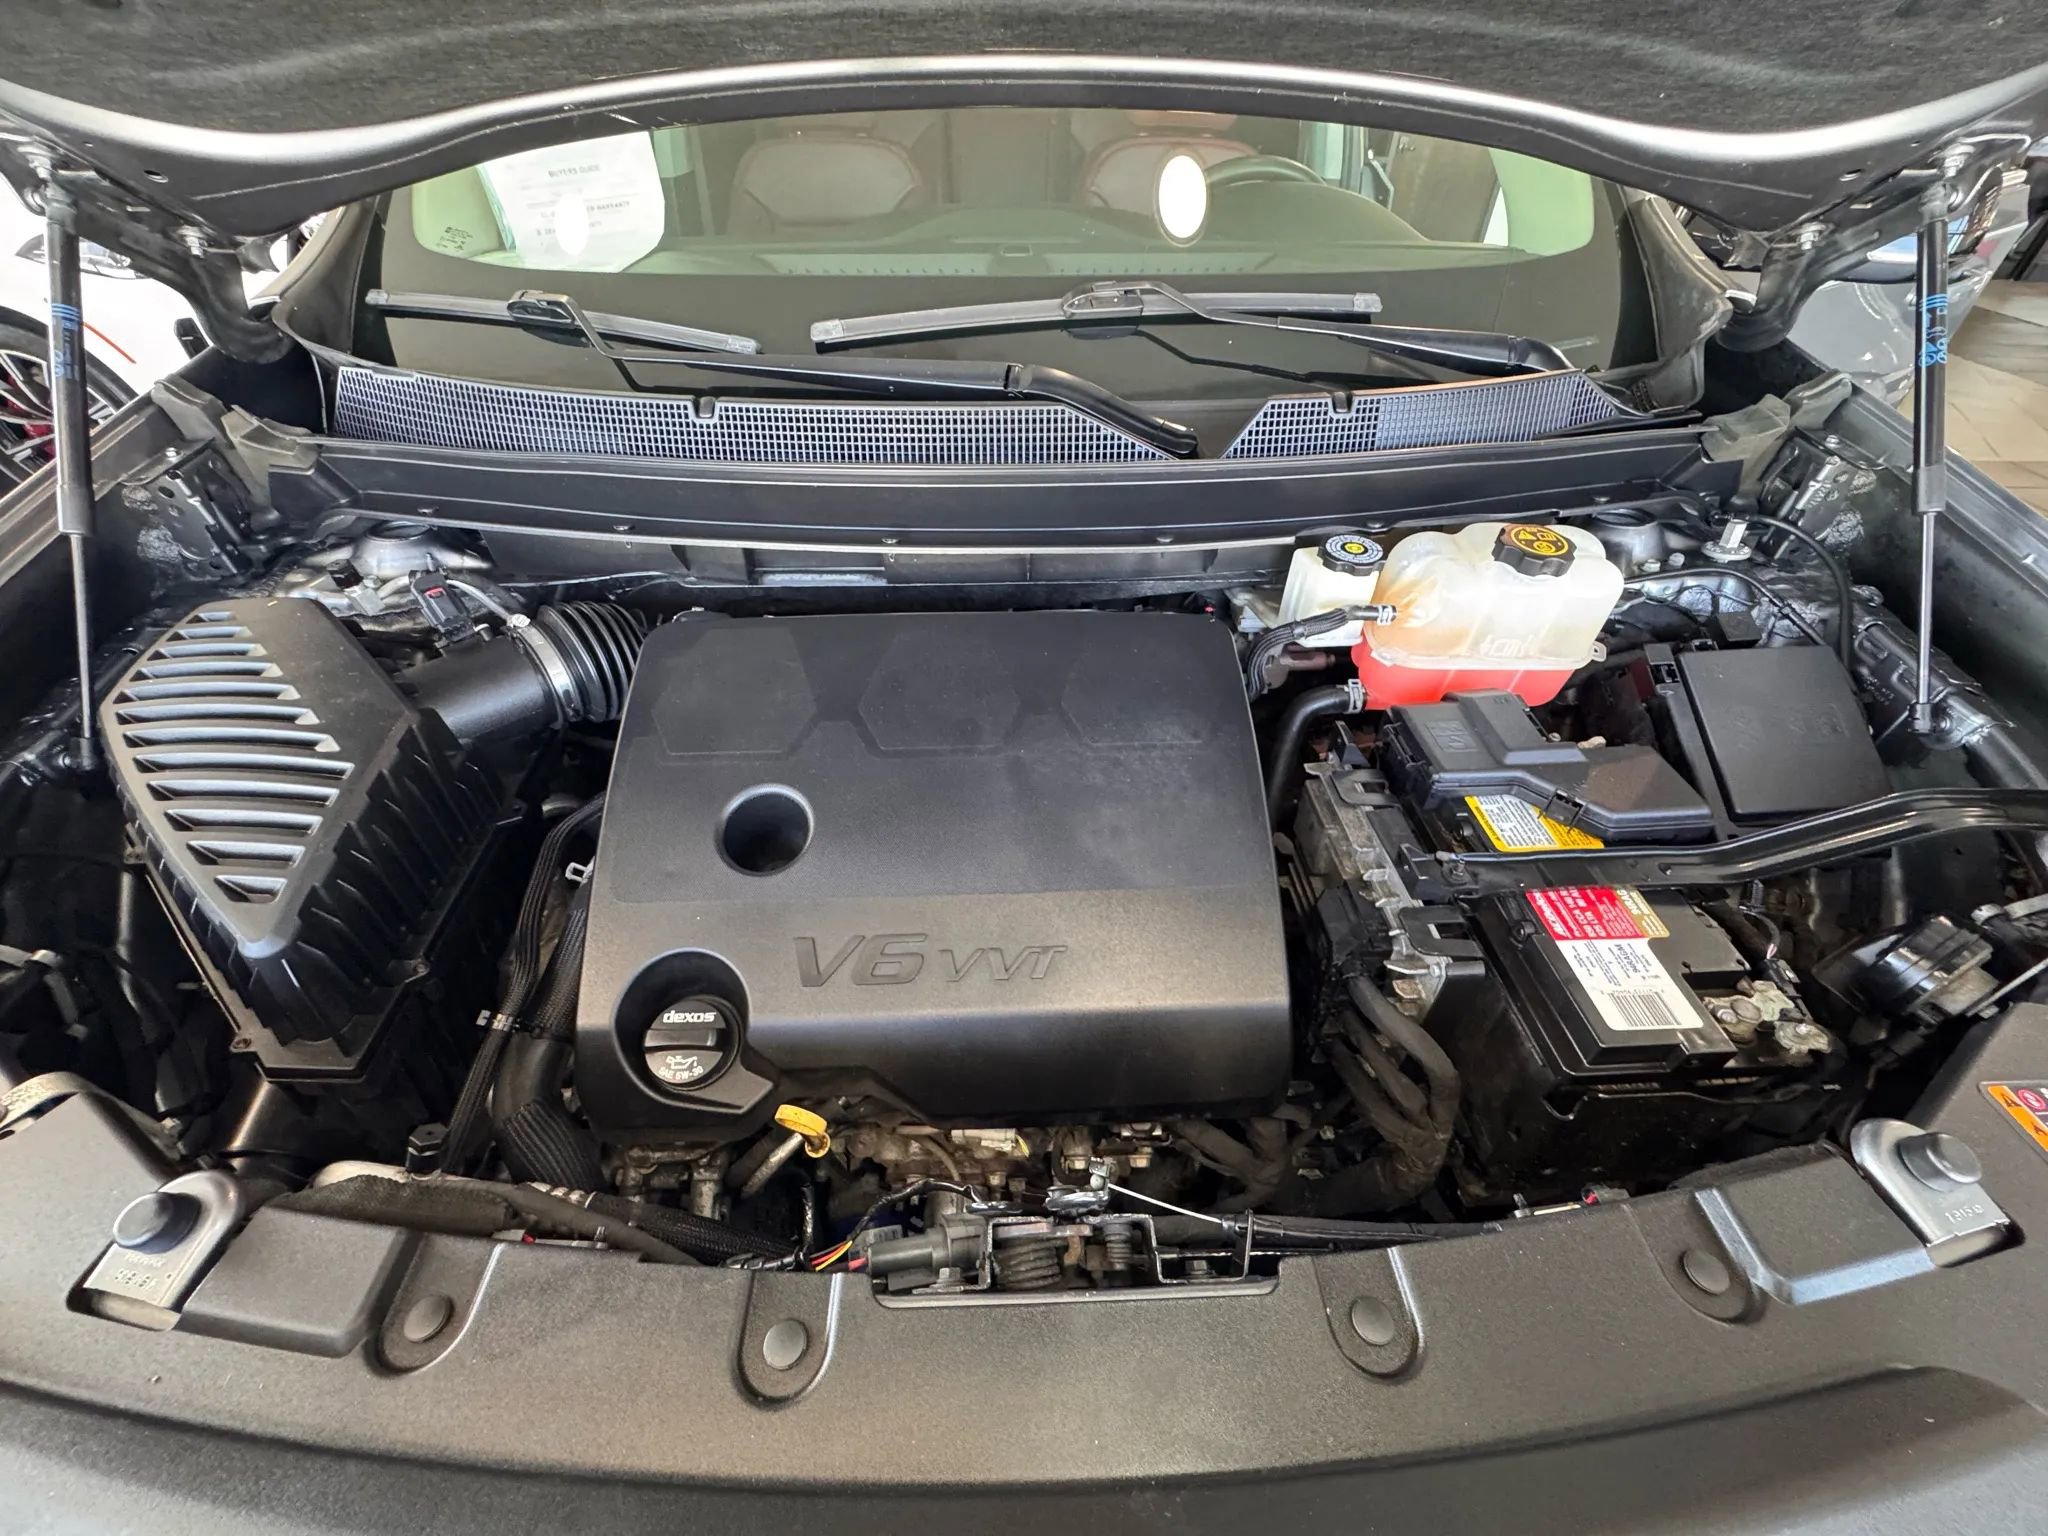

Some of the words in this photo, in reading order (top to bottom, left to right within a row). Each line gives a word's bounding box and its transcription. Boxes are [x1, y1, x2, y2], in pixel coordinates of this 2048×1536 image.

[794, 933, 928, 988] V6
[938, 944, 1068, 983] VVT
[662, 1010, 717, 1024] dexos
[659, 1066, 674, 1080] SAE
[675, 1065, 704, 1080] 5W-30
